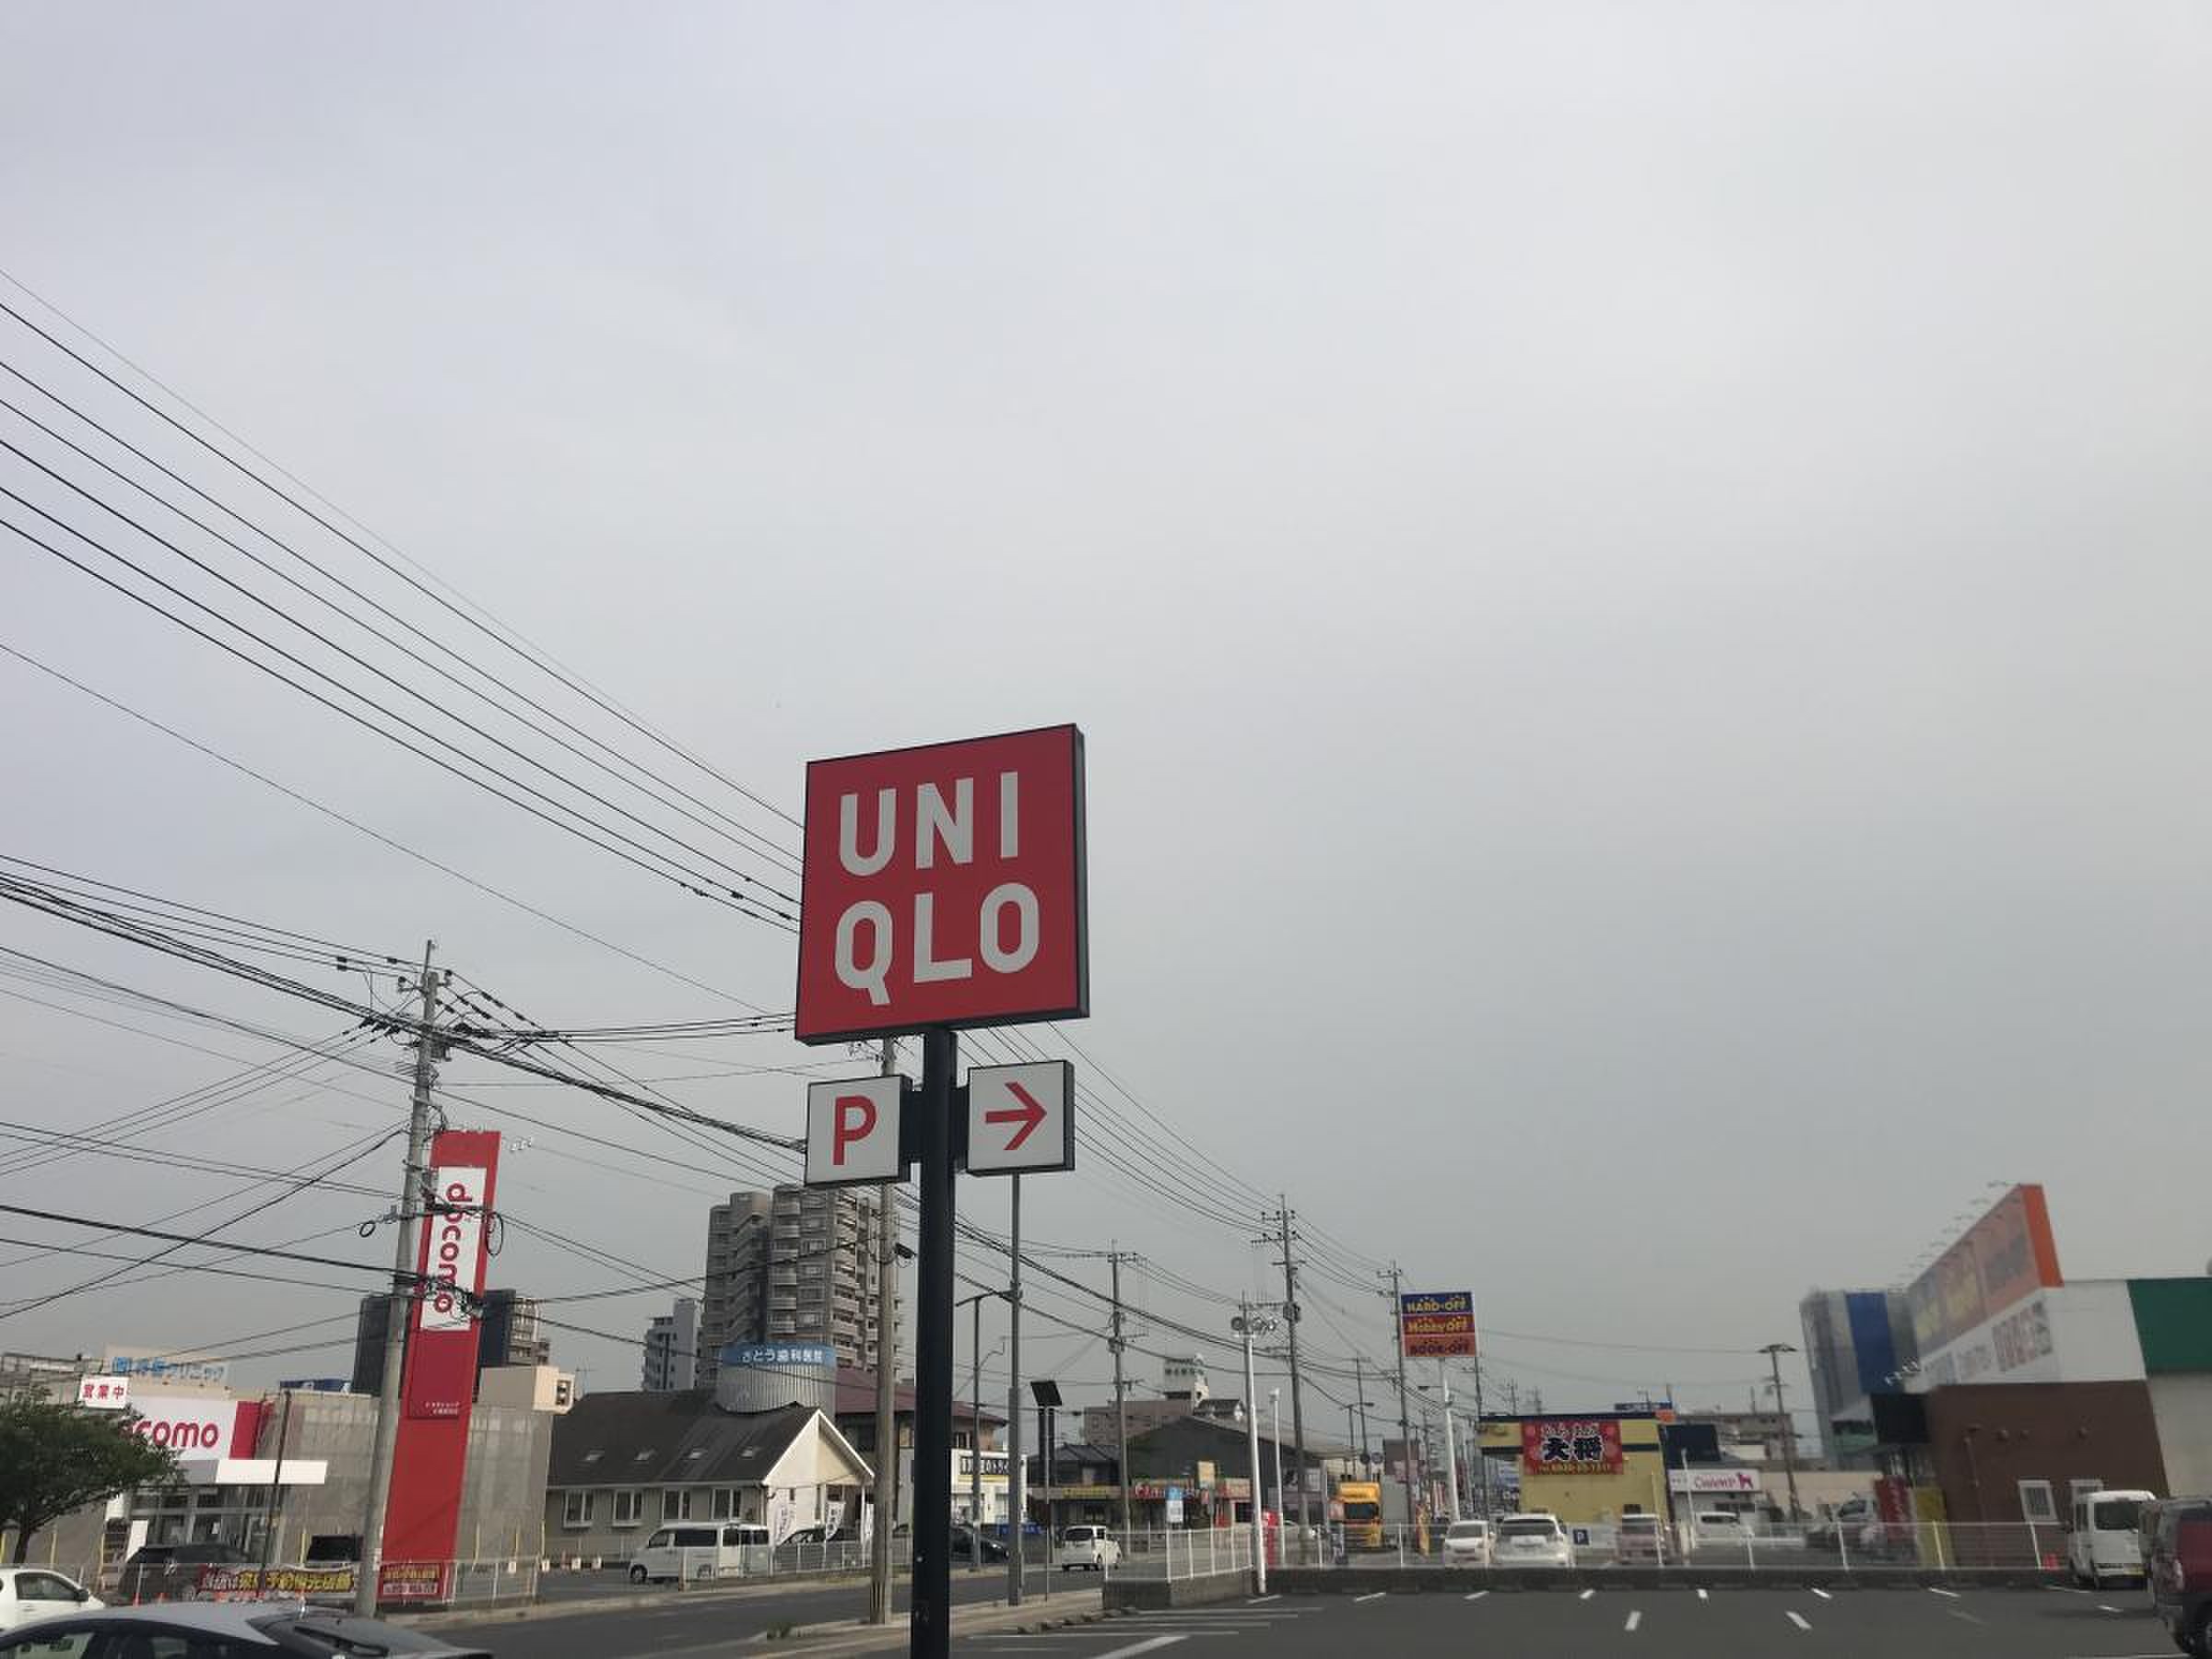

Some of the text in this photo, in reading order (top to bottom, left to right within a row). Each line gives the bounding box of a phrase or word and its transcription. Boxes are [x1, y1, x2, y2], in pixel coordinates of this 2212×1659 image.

[839, 771, 1018, 877] UNI
[834, 882, 1041, 1006] QLO
[832, 1094, 877, 1166] P
[82, 1384, 124, 1400] 営業中
